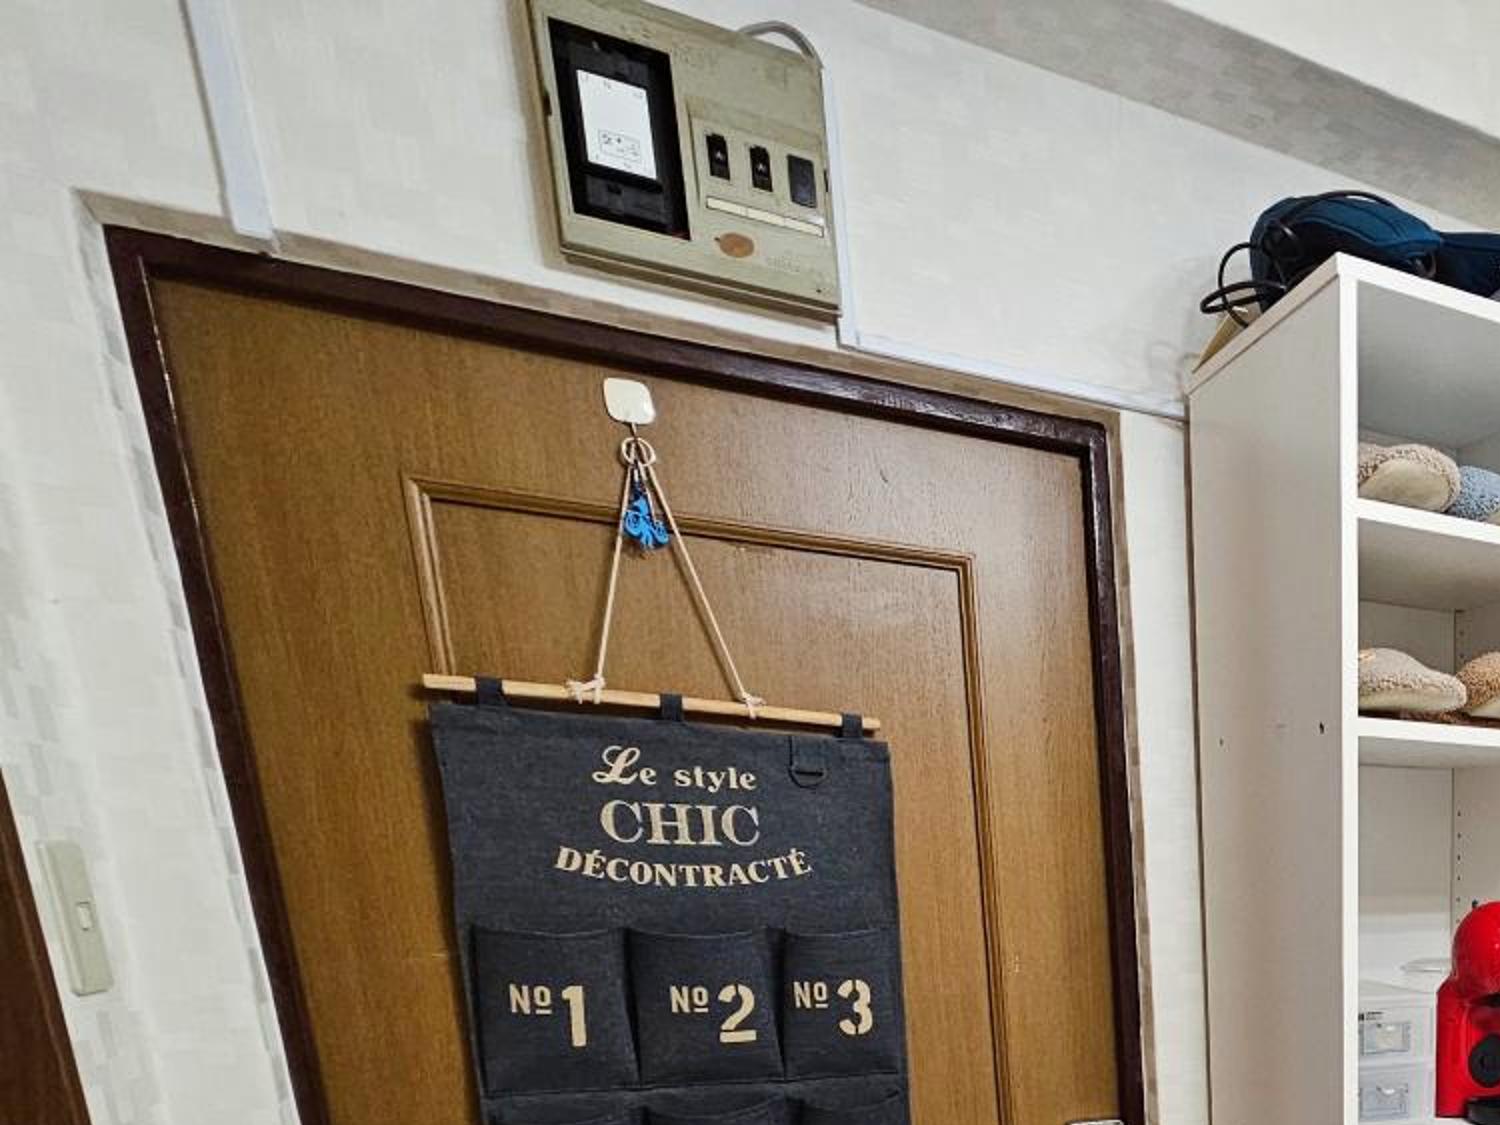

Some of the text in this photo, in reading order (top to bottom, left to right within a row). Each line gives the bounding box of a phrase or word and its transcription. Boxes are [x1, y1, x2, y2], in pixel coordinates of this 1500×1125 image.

[592, 745, 757, 793] Le style
[600, 799, 761, 847] CHIC
[554, 847, 813, 888] DÉCONTRACTÉ
